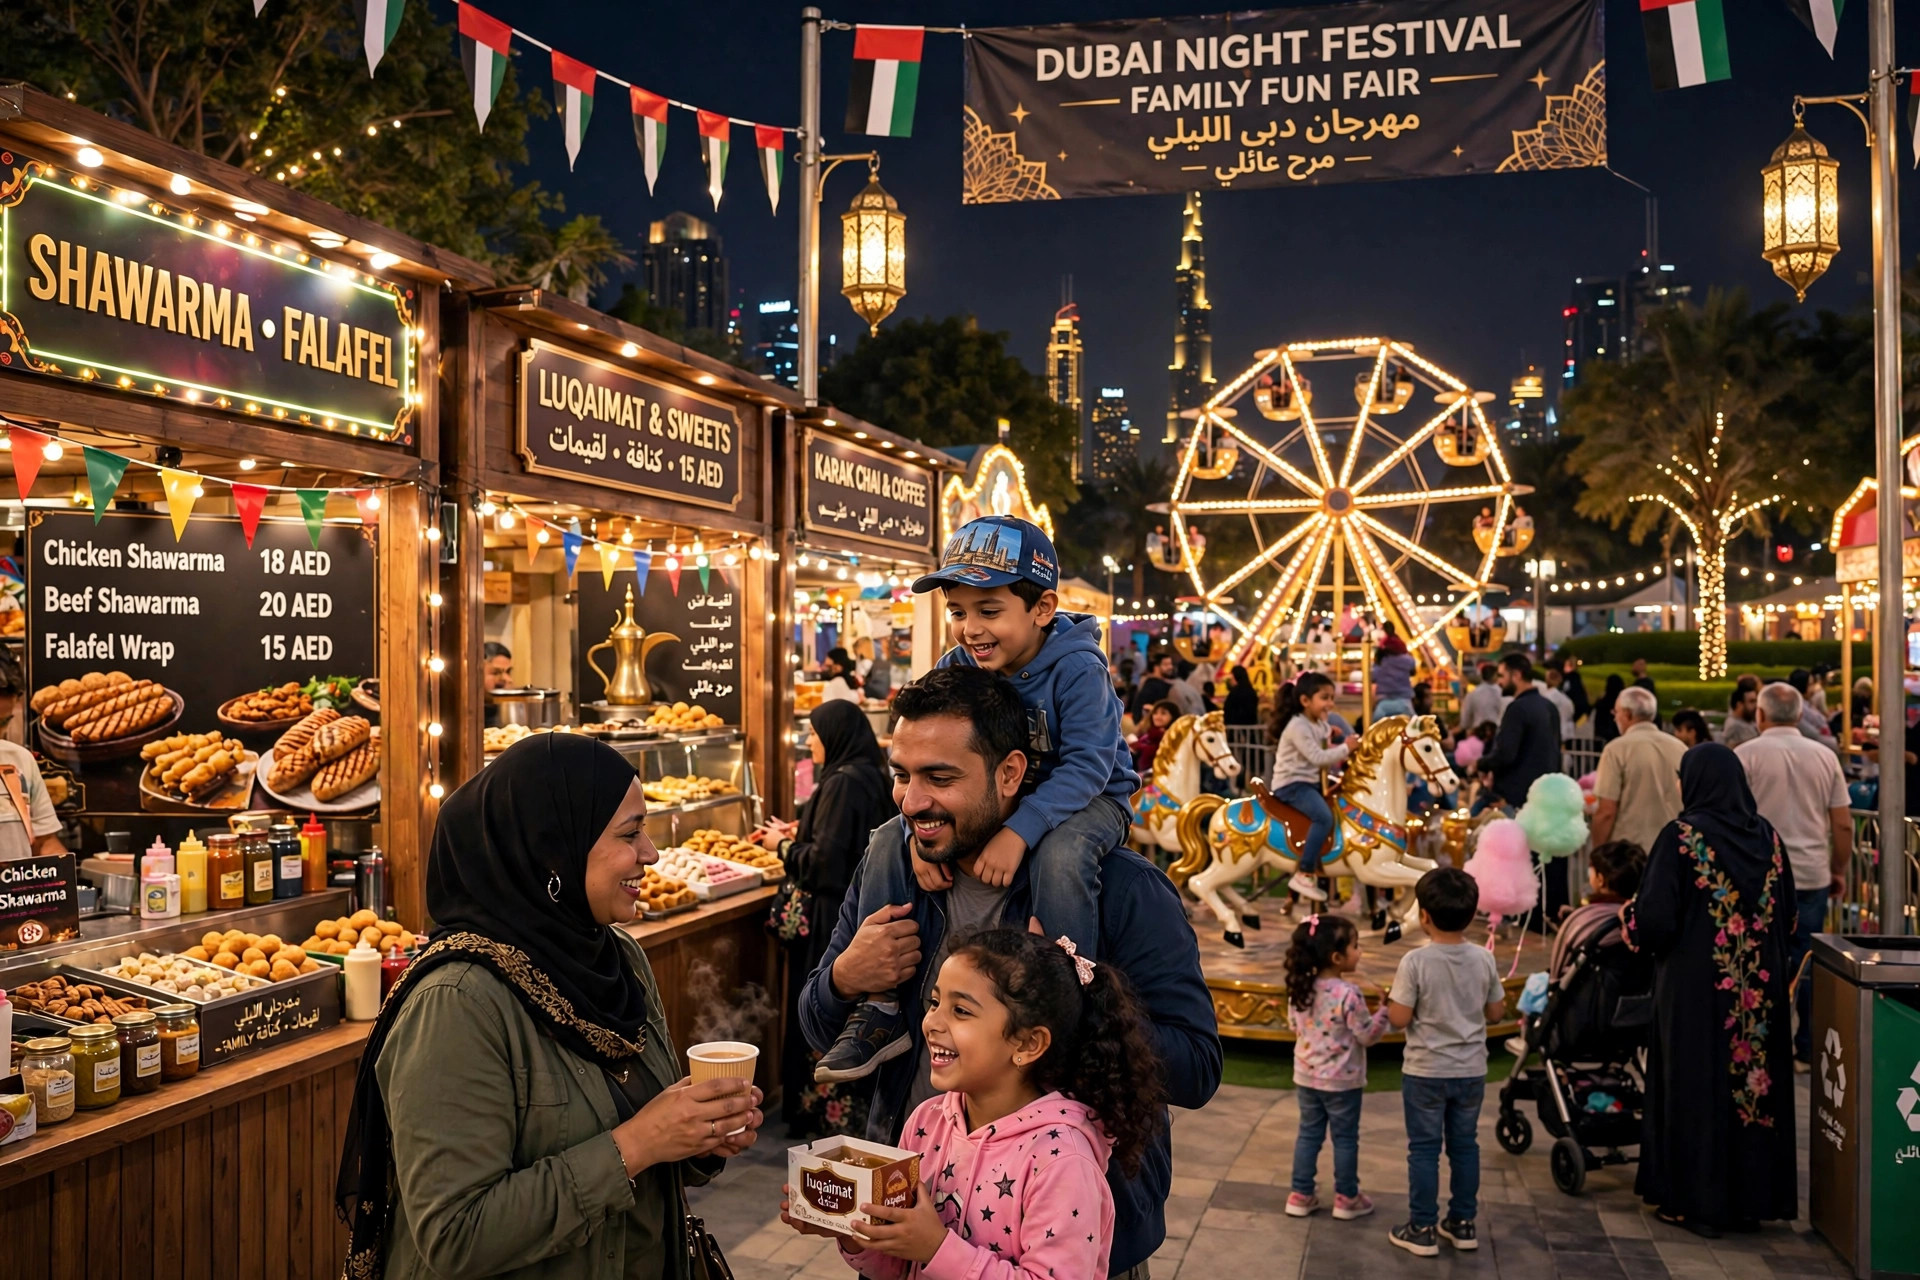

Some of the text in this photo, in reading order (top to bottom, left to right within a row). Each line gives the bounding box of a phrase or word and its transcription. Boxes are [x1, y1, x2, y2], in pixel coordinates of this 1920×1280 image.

[1036, 14, 1521, 81] DUBAI NIGHT FESTIVAL
[1131, 68, 1420, 113] FAMILY FUN FAIR
[1147, 115, 1231, 160] الليلي
[1305, 108, 1420, 144] مهرجان
[1214, 150, 1335, 187] مرح عائلي
[28, 233, 398, 388] SHAWARMA FALAFEL
[539, 368, 731, 454] LUQAIMAT & SWEETS
[549, 425, 723, 489] 15 AED كنافة لقيمات
[815, 452, 926, 508] KARAK CHAI & COFFEE
[44, 539, 331, 576] Chicken Shawarma 18 AED
[44, 586, 332, 618] Beef Shawarma 20 AED
[45, 632, 333, 667] Falafel Wrap 15 AED
[0, 864, 57, 883] Chicken
